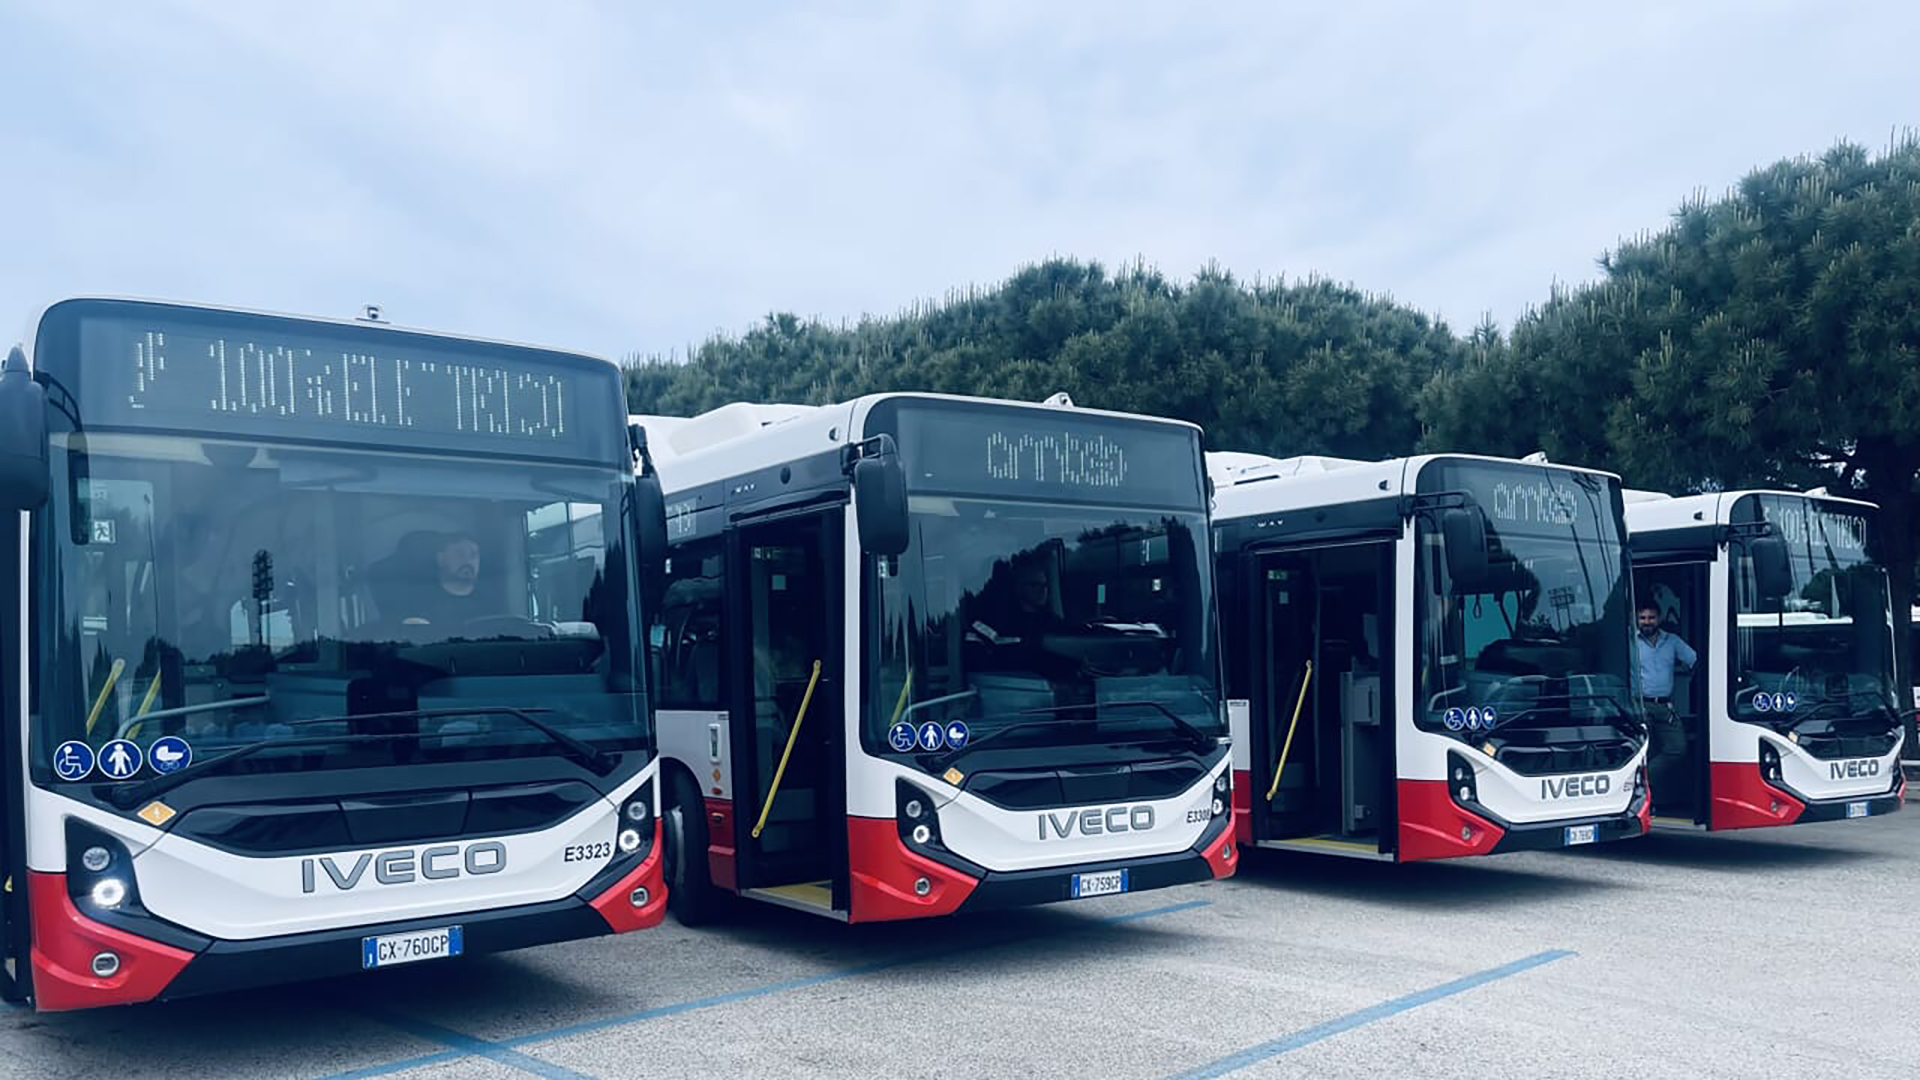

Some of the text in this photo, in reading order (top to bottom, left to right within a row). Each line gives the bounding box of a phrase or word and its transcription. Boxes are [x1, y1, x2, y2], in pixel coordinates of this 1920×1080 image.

[1830, 759, 1879, 780] IVECO
[1541, 774, 1611, 800] IVECO
[1038, 804, 1155, 840] IVECO
[563, 841, 611, 862] E3323
[301, 840, 507, 894] IVECO
